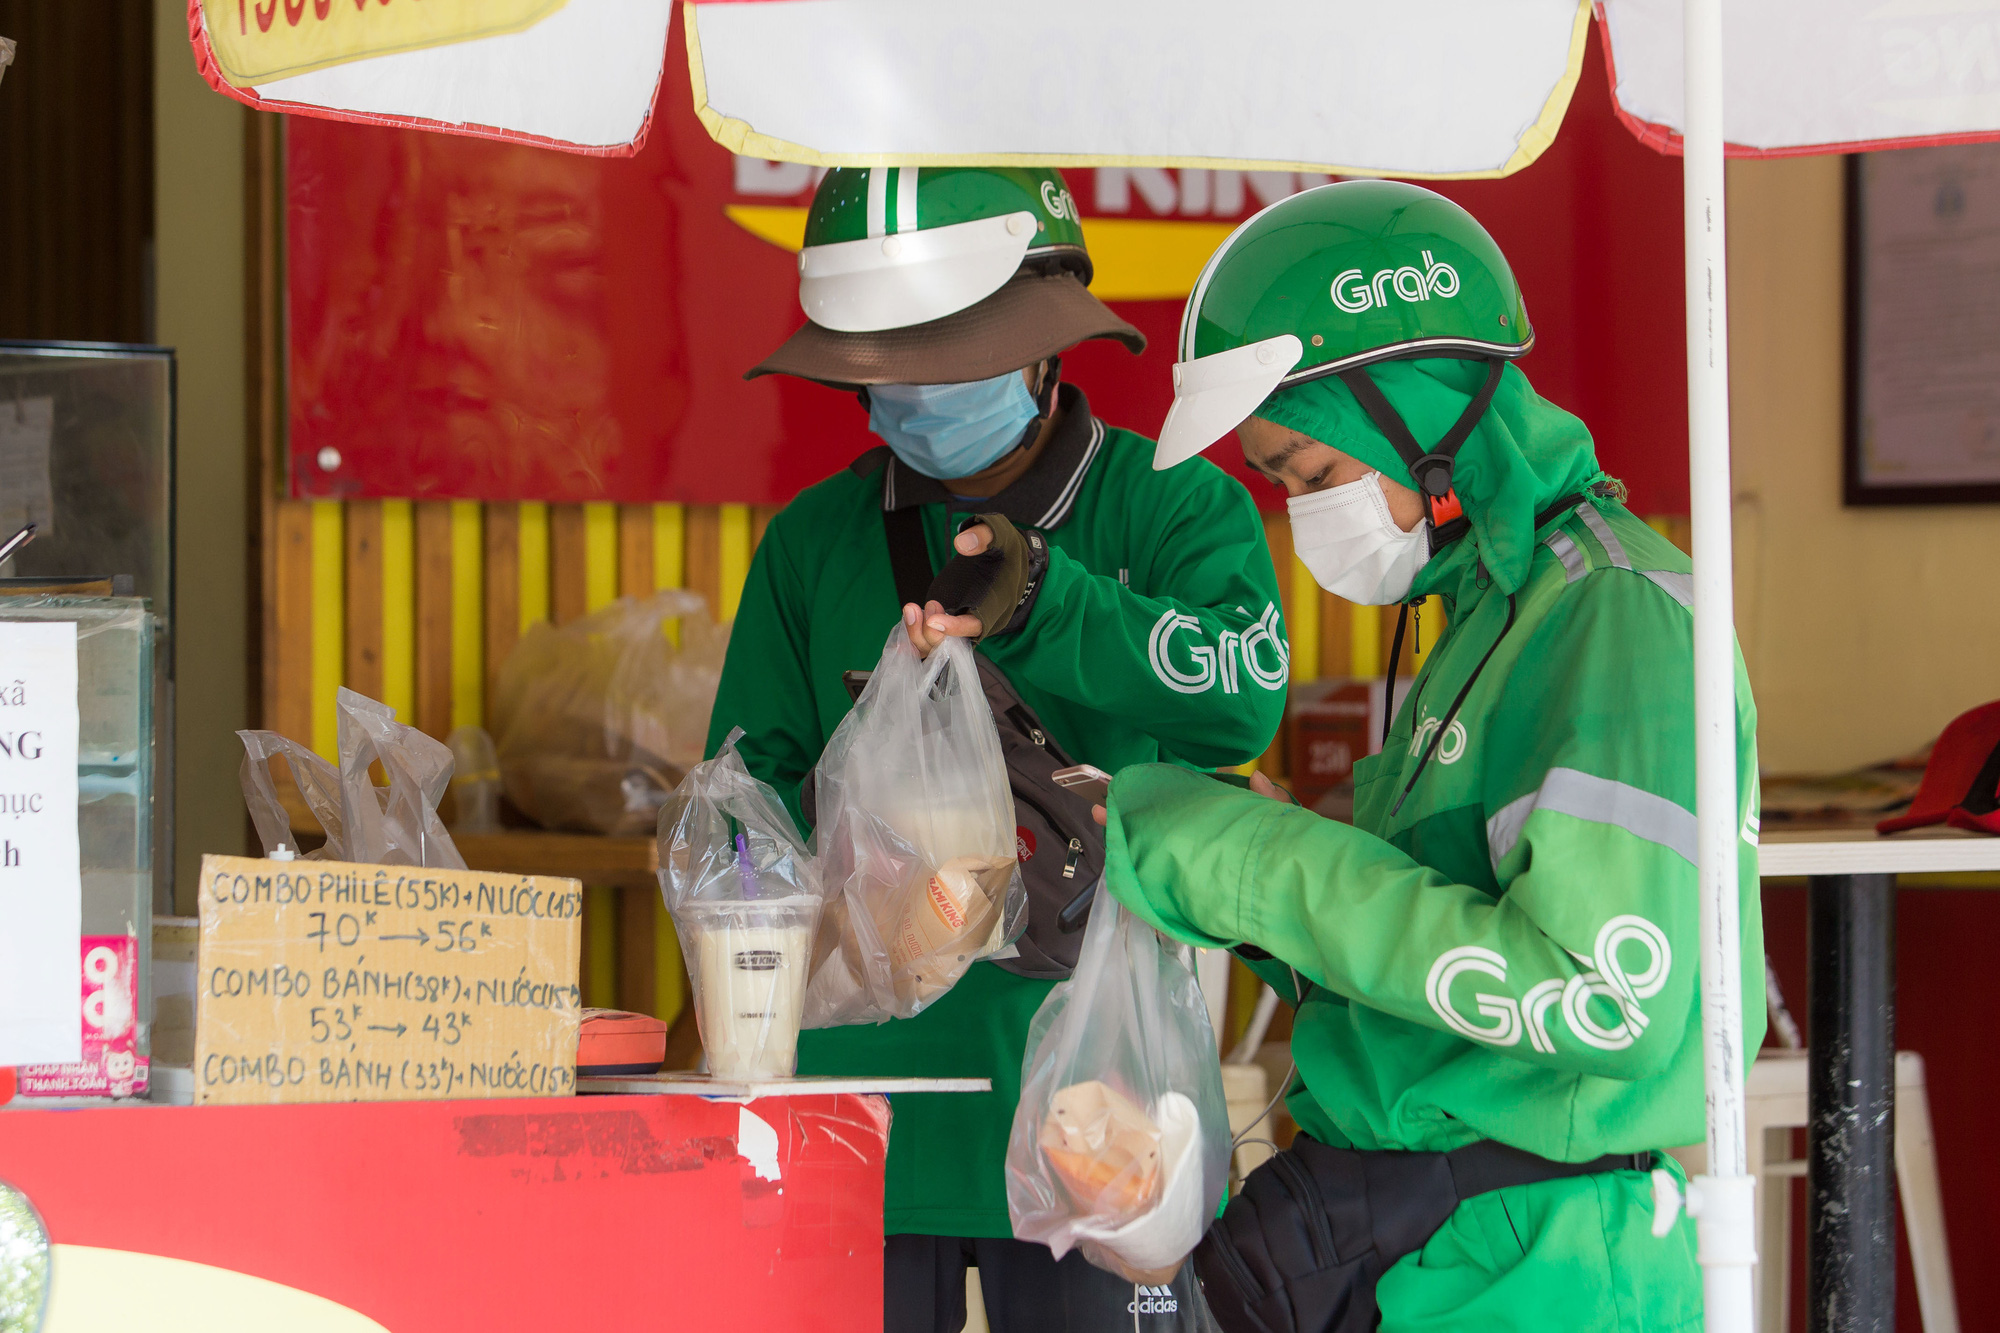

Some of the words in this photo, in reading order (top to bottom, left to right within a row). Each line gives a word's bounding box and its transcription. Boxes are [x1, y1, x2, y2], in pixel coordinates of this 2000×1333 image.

[1330, 250, 1461, 314] Grab
[212, 872, 311, 904] COMBO
[211, 966, 311, 998] COMBO
[204, 1053, 305, 1087] COMBO
[320, 1042, 392, 1091] BÁNH
[1127, 1297, 1178, 1314] adidas
